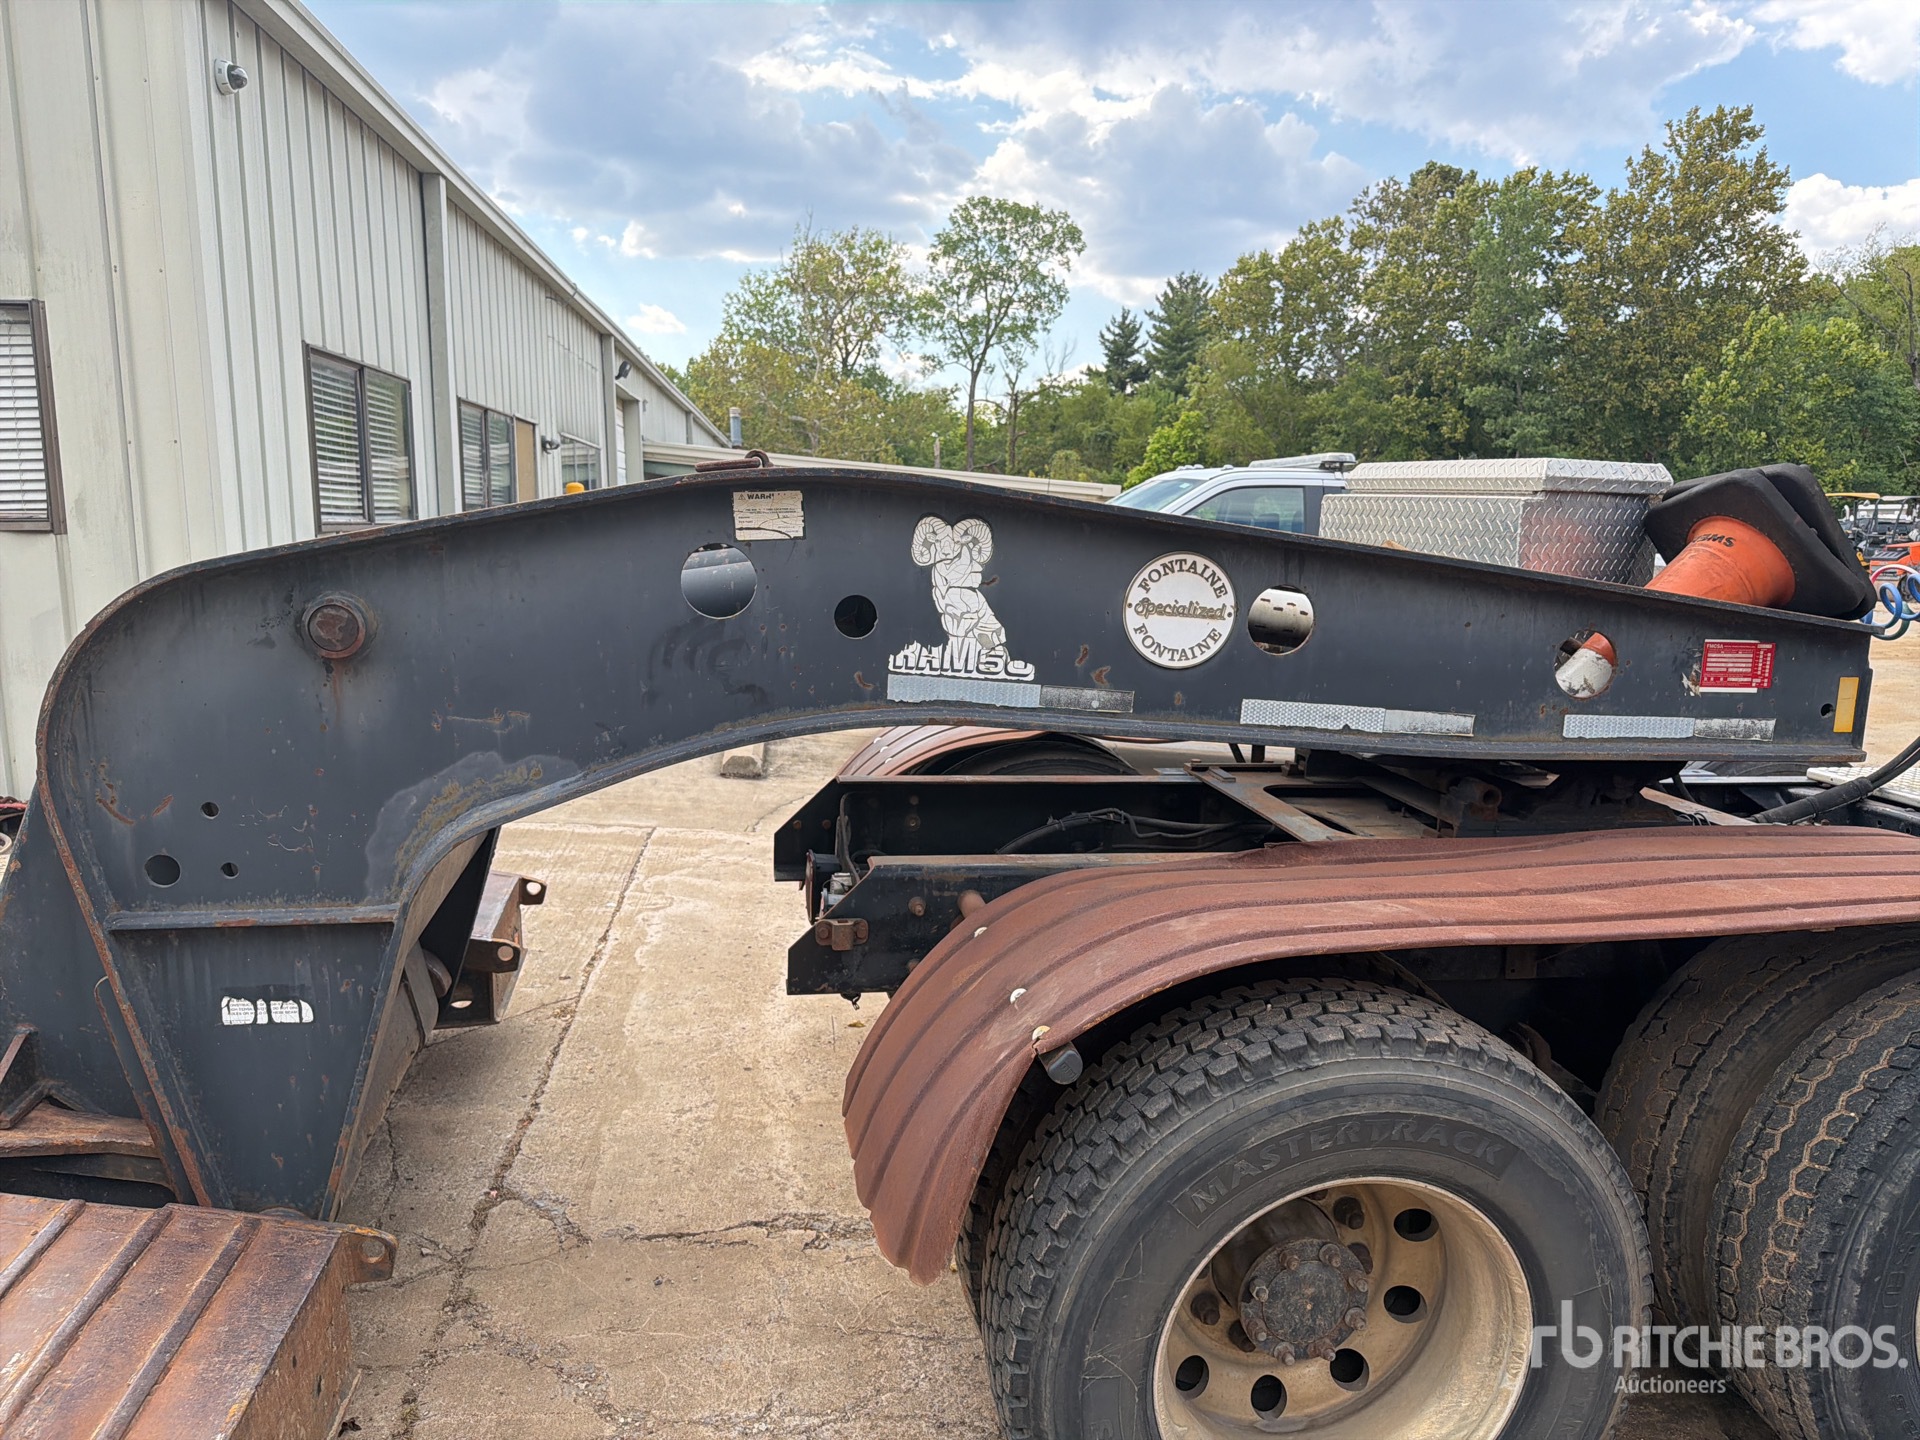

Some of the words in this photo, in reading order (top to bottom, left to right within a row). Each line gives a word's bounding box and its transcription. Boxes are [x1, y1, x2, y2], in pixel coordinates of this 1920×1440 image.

[1138, 558, 1229, 599] FONTAINE
[1134, 597, 1227, 621] Specialized
[1133, 623, 1223, 662] FONTAINE
